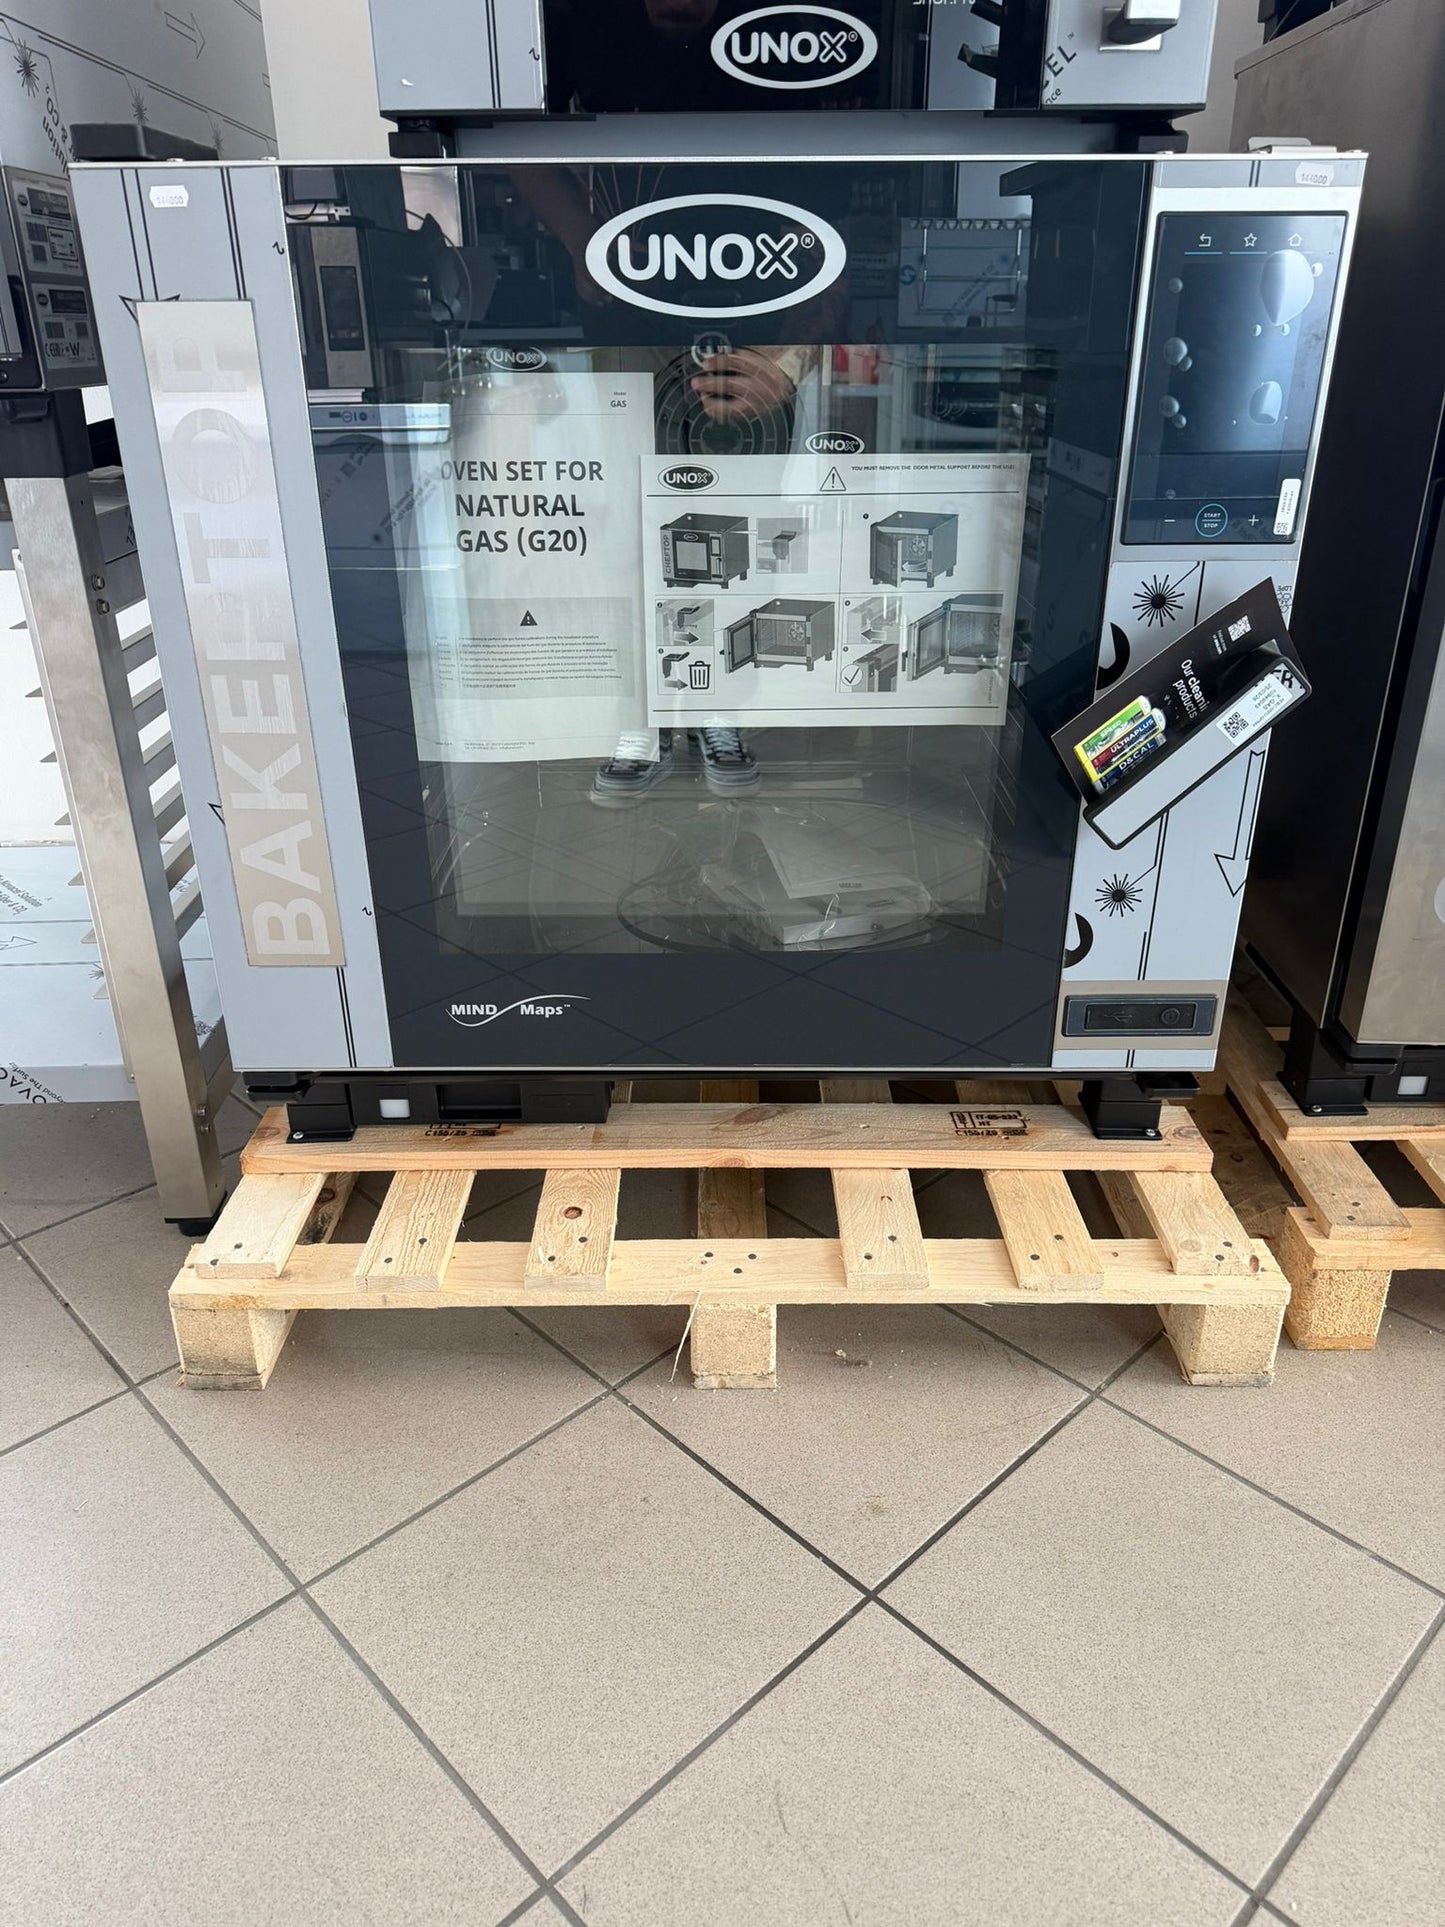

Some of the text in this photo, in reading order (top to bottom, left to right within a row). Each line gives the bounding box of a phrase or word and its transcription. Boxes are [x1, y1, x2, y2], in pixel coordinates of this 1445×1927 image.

[610, 400, 627, 408] GAS
[440, 460, 604, 482] OVEN SET FOR
[456, 494, 585, 518] NATURAL
[456, 526, 588, 557] GAS (G20)
[664, 534, 672, 574] CHEFTOP
[161, 335, 333, 957] BAKERTOP
[1181, 658, 1193, 678] Our
[1173, 681, 1197, 719] products
[1110, 718, 1155, 753] ULTRAPLUS
[1119, 743, 1155, 771] D&CAL
[451, 1003, 498, 1016] MIND
[29, 1077, 43, 1091] The
[42, 1087, 66, 1104] eyond
